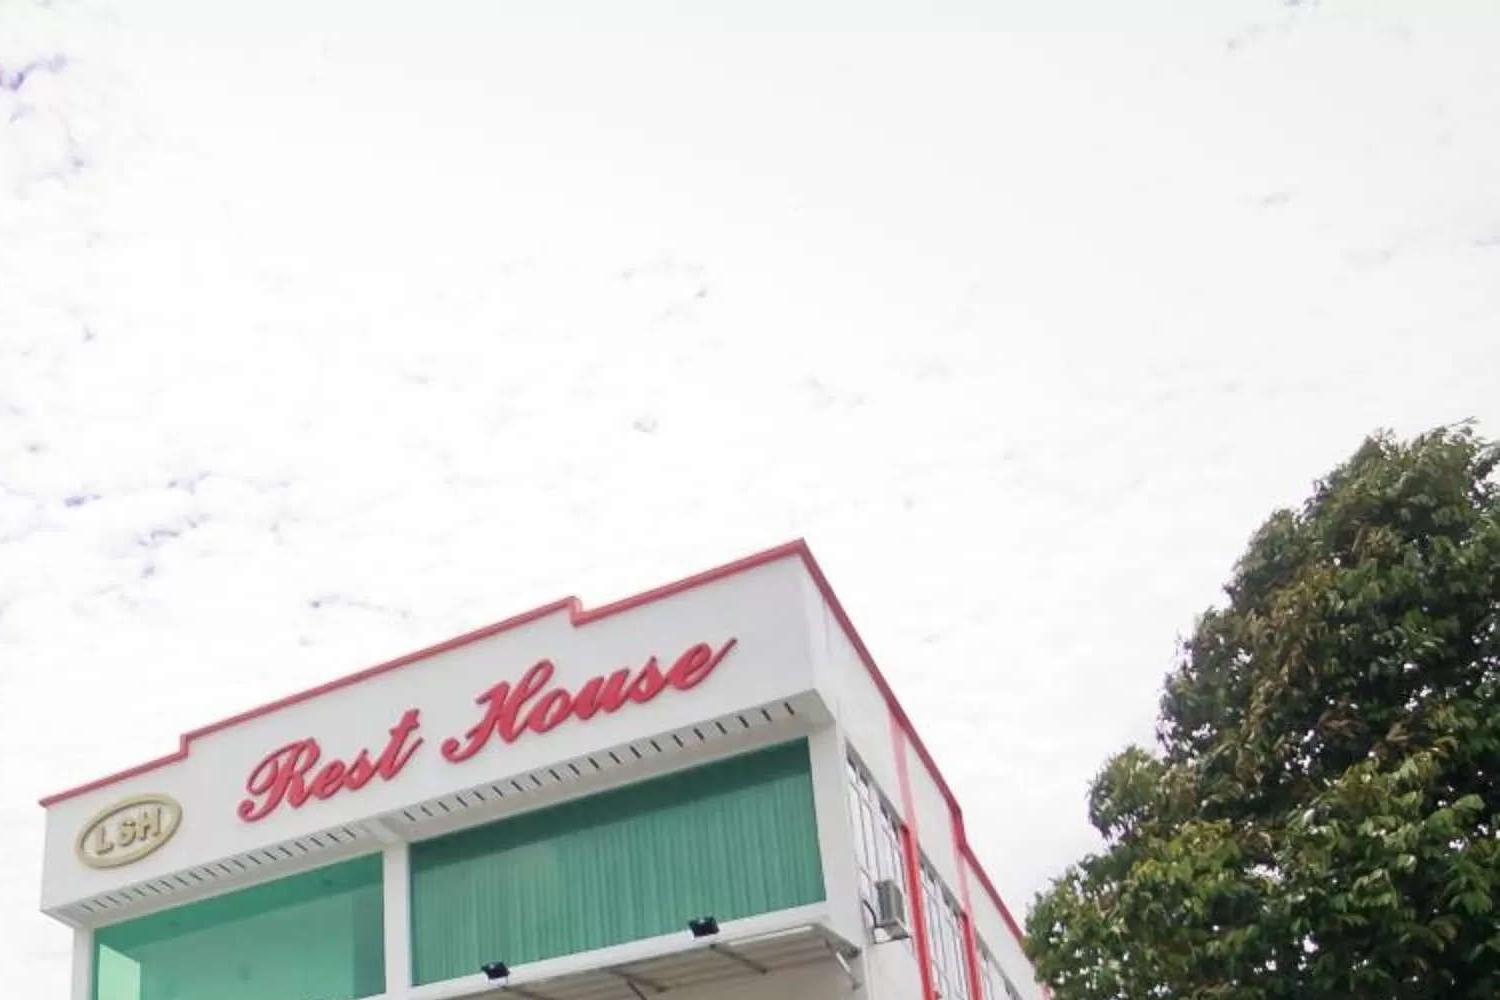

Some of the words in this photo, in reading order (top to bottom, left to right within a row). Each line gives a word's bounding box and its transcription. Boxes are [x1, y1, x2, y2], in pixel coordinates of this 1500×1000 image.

[238, 708, 424, 822] Rest
[442, 638, 737, 763] House
[95, 806, 162, 855] LSH
